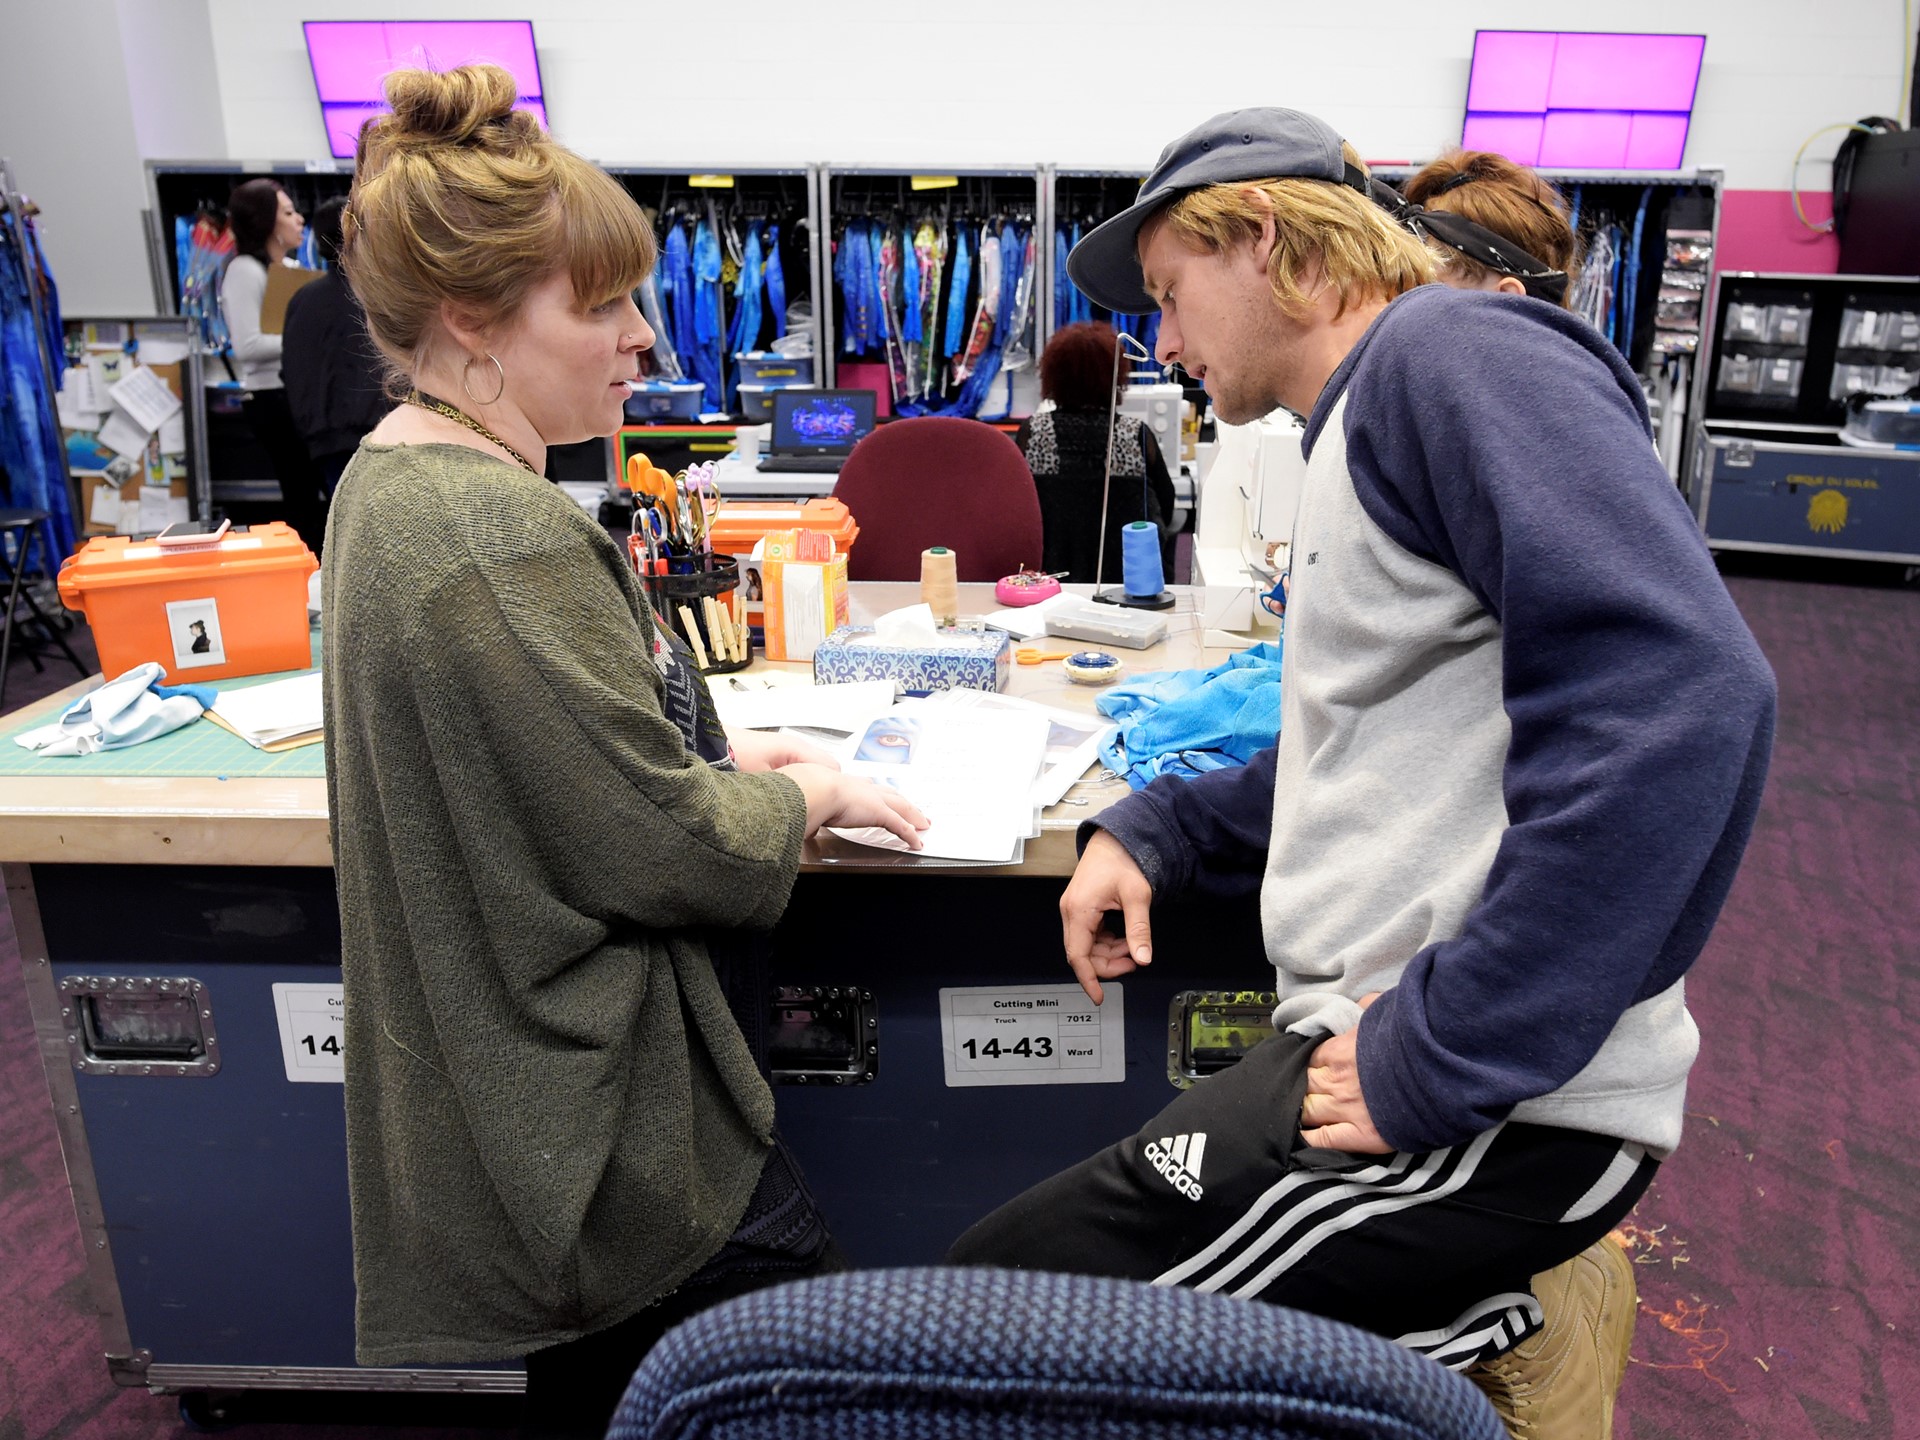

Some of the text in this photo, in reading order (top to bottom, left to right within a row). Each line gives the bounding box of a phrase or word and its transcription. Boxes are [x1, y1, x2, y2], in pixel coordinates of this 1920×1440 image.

[993, 999, 1059, 1009] Cutting Mini
[1067, 1015, 1092, 1023] 7012
[962, 1036, 1053, 1059] 14-43
[1067, 1048, 1093, 1056] Ward
[1144, 1142, 1204, 1202] adidas
